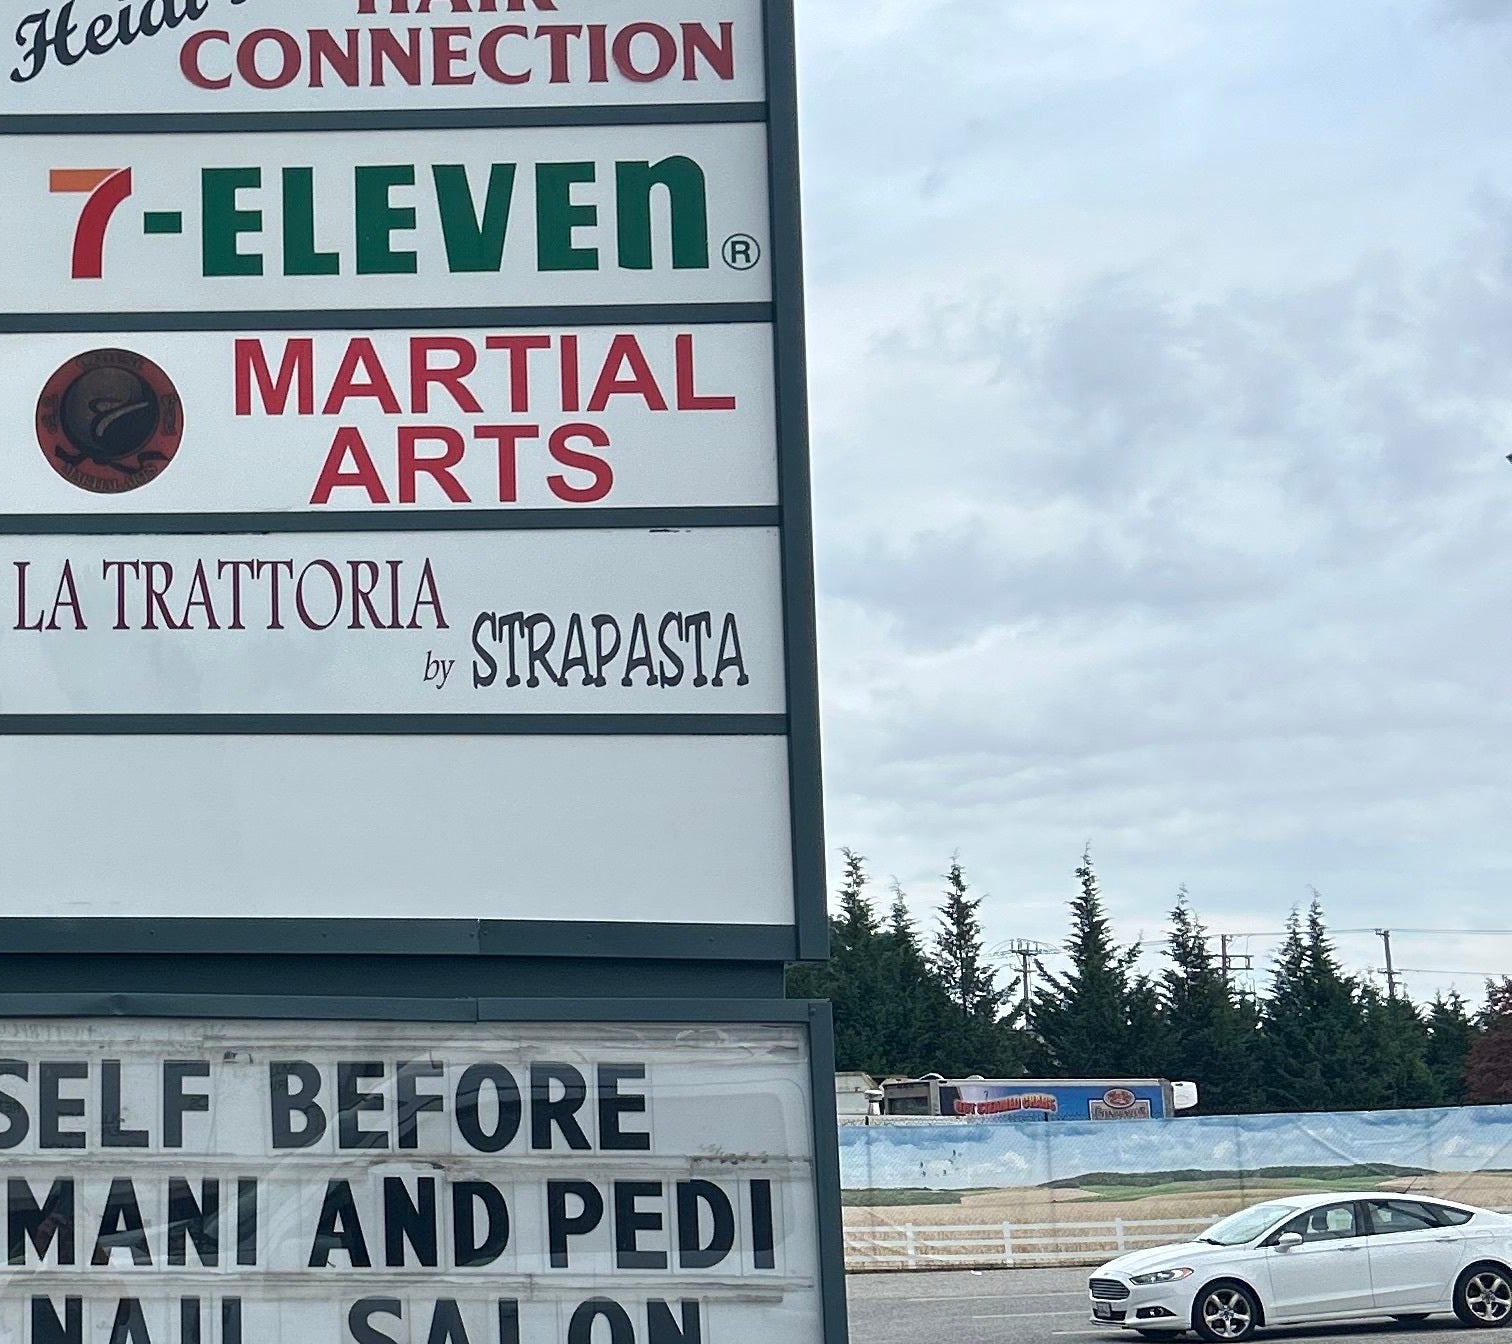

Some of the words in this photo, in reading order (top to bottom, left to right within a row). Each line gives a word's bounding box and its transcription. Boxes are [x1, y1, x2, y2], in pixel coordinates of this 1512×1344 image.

[179, 22, 734, 90] CONNECTION
[235, 334, 736, 415] MARTIAL
[309, 423, 613, 504] ARTS
[13, 559, 88, 632] LA
[103, 558, 449, 630] TRATTORIA
[423, 651, 455, 689] by
[472, 611, 749, 689] STRAPASTA
[269, 1059, 651, 1152] BEFORE
[6, 1176, 259, 1267] MANI
[307, 1176, 511, 1269] AND
[548, 1177, 775, 1270] PEDI
